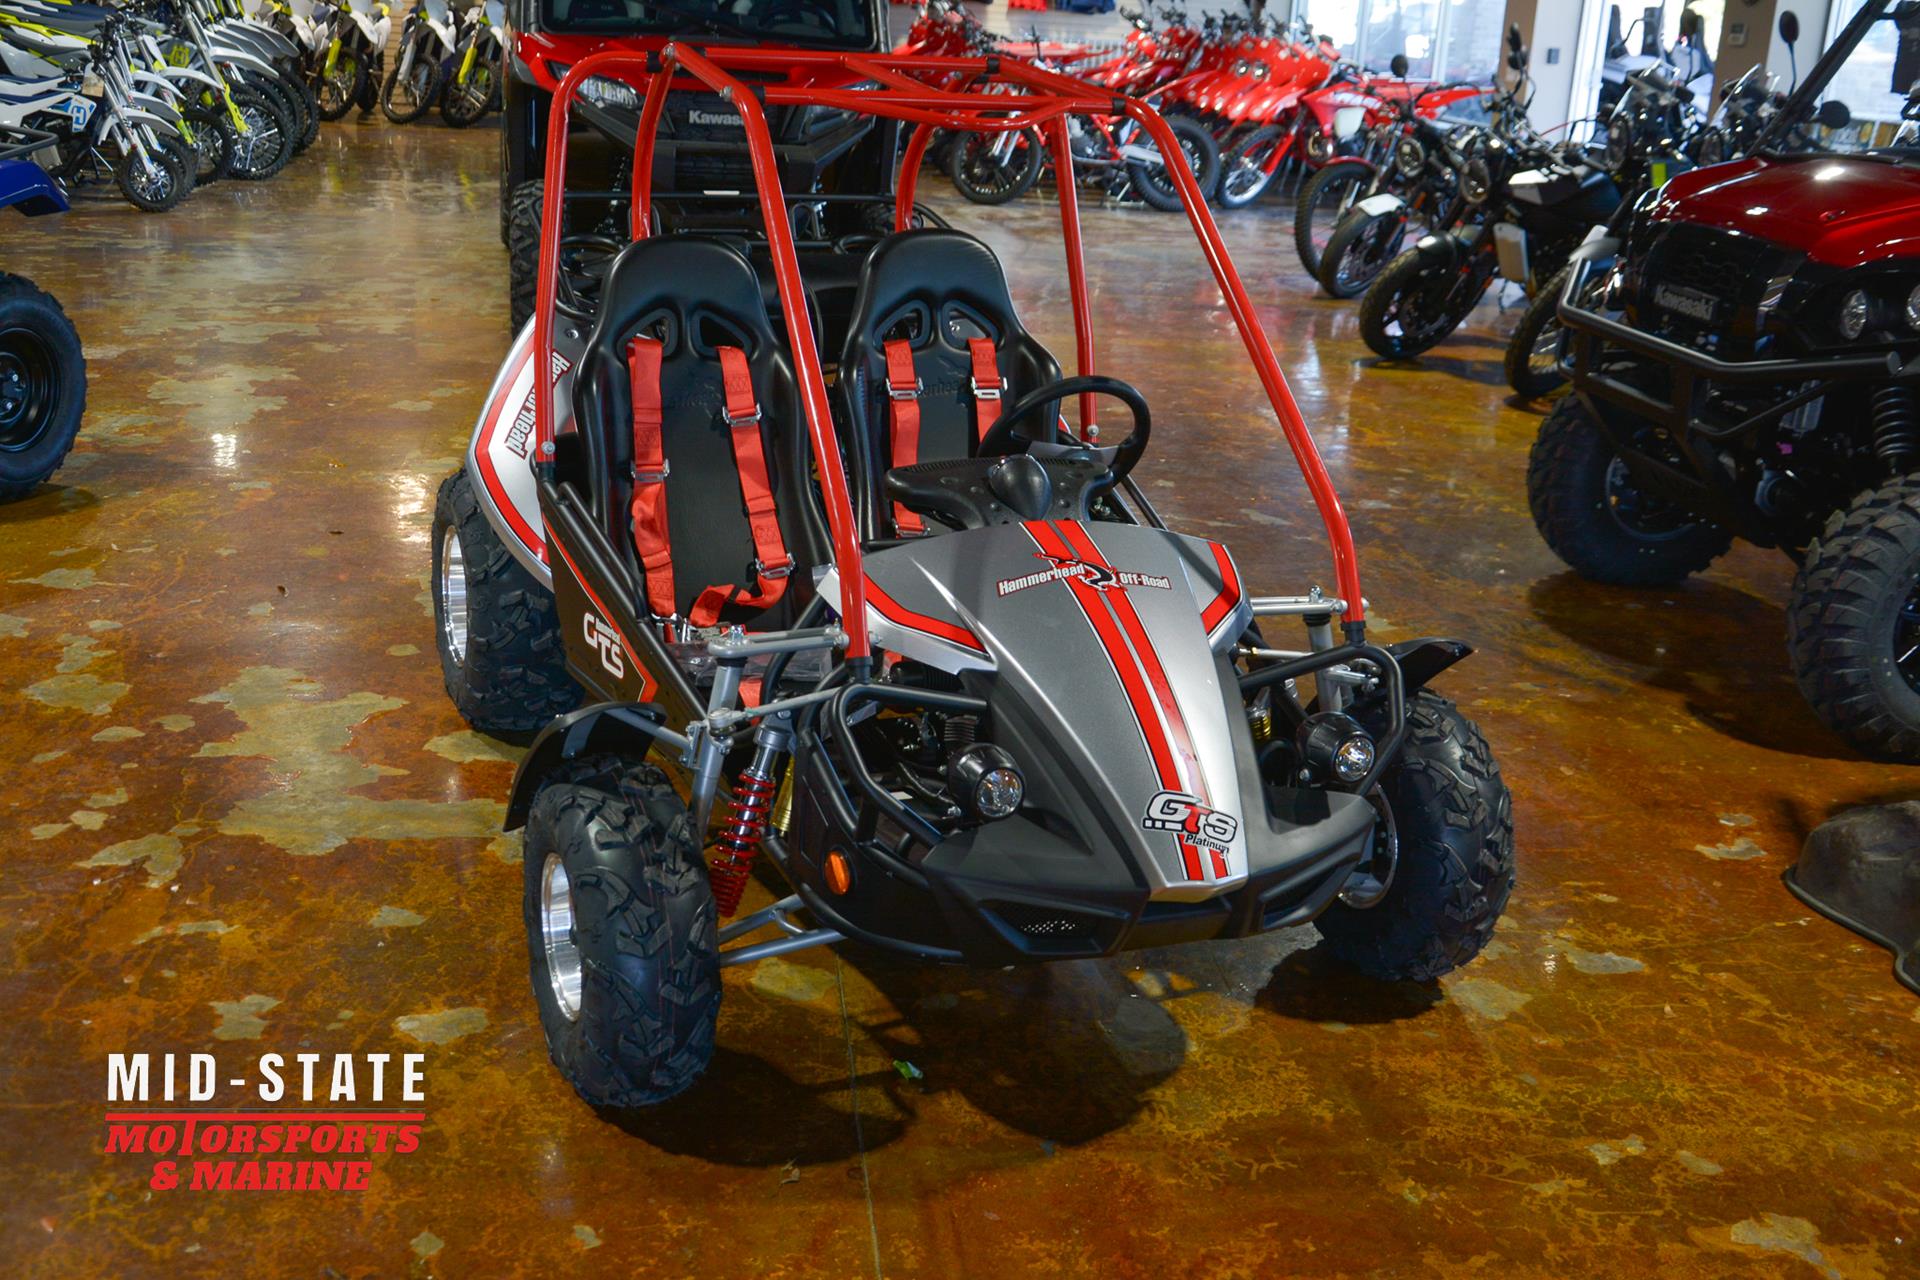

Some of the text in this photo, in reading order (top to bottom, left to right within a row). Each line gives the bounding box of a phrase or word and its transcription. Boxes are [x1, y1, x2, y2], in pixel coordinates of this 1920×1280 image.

[688, 110, 746, 126] Kawas
[998, 563, 1171, 596] Hammerhead Off-Road
[583, 611, 625, 679] GTS
[1145, 791, 1238, 844] GTS
